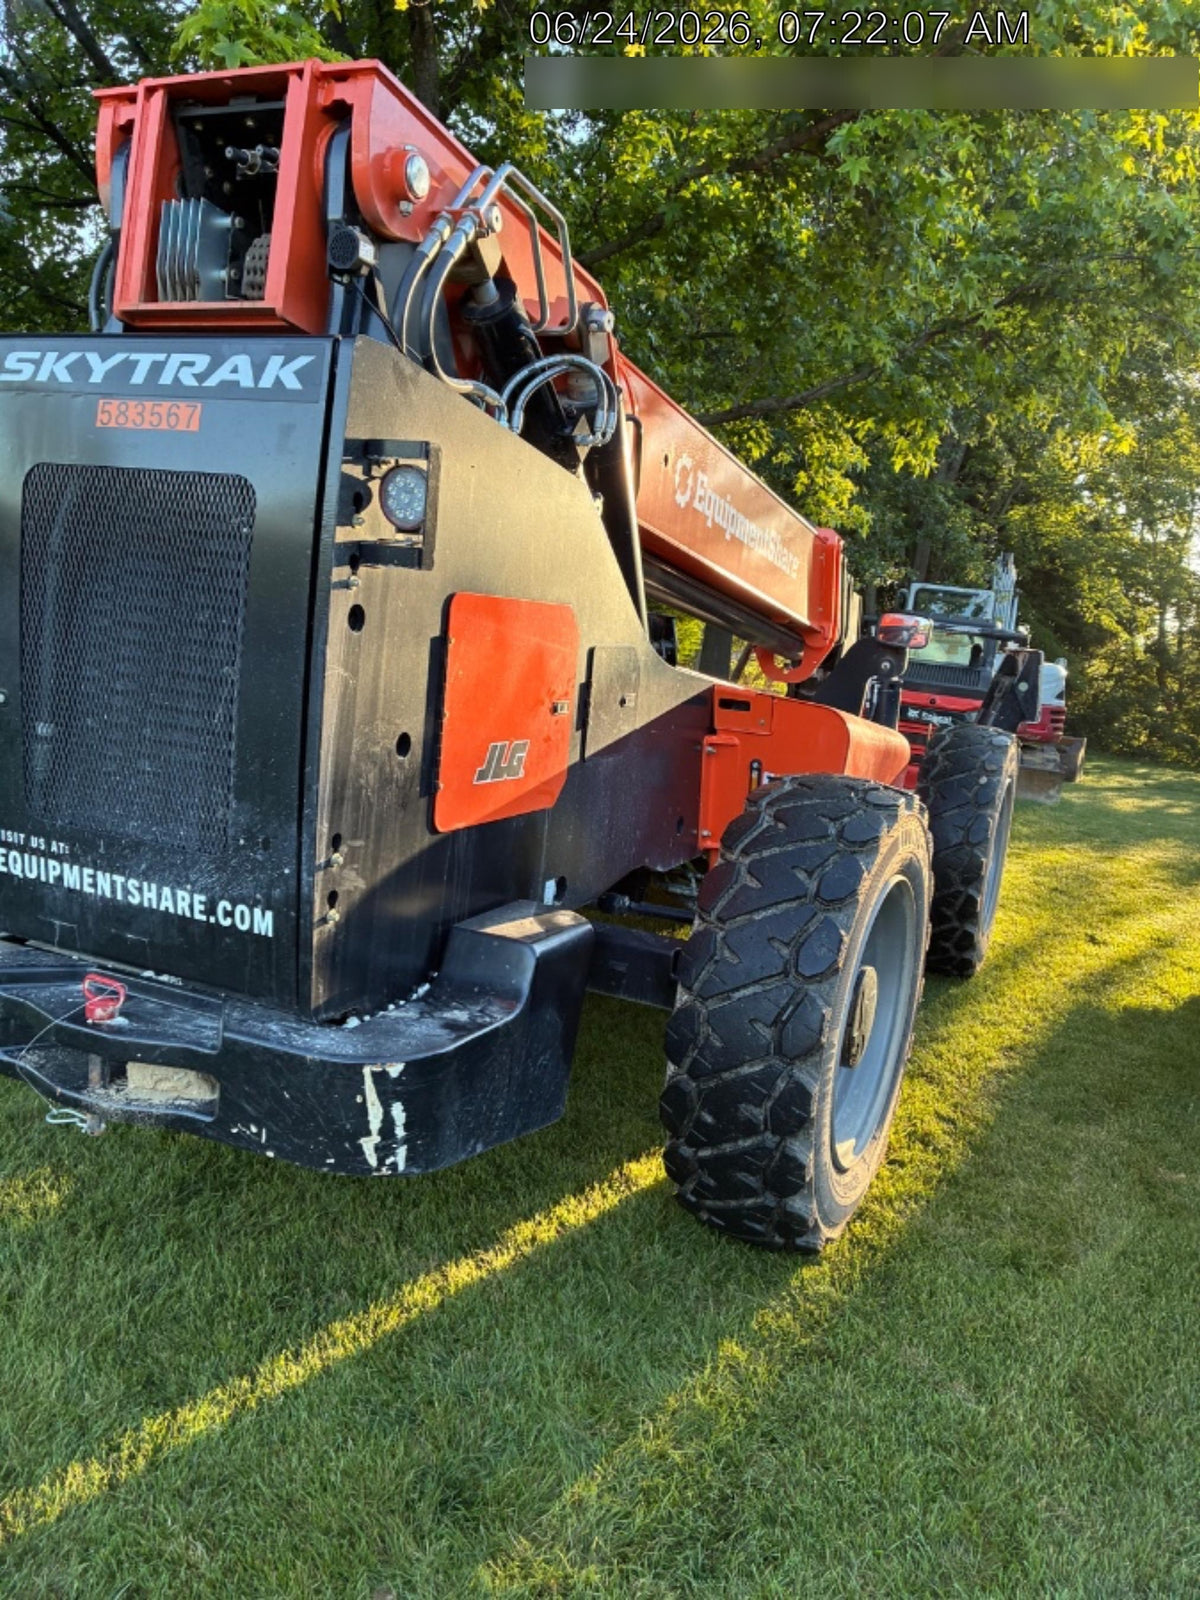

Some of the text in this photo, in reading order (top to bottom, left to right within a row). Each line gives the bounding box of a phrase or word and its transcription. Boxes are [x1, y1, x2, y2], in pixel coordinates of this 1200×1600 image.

[0, 351, 317, 390] SKYTRAK
[99, 401, 199, 429] 583567
[693, 470, 800, 579] EquipmentShare
[473, 739, 530, 784] JLG
[0, 829, 25, 845] ISIT
[30, 834, 45, 850] US
[0, 847, 275, 938] EQUIPMENTSHARE.COM
